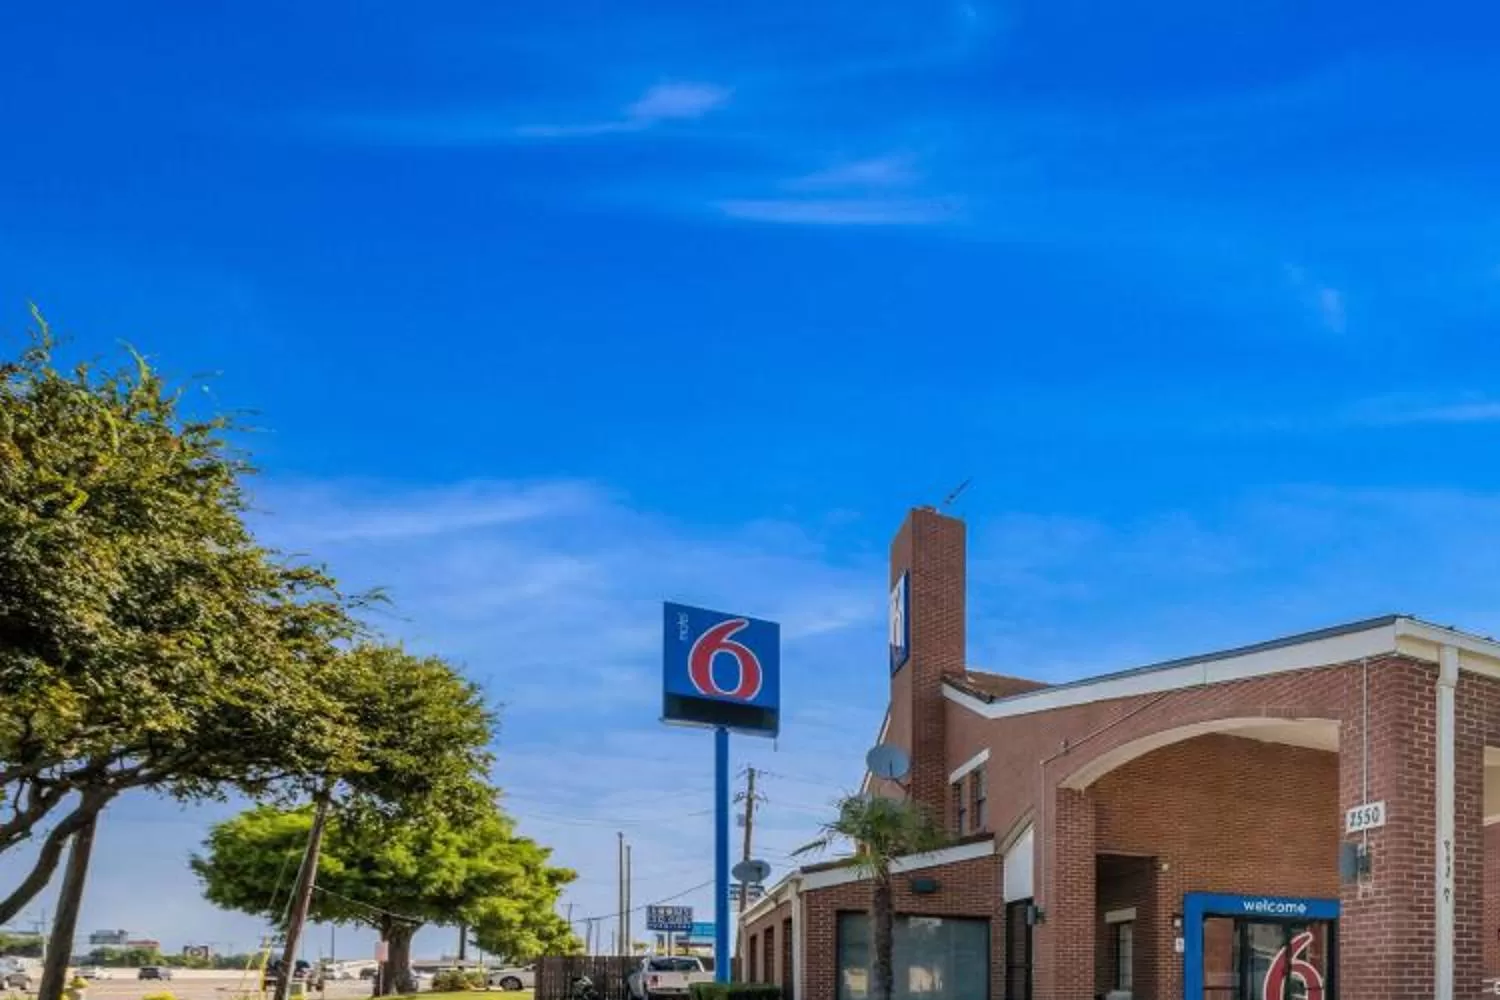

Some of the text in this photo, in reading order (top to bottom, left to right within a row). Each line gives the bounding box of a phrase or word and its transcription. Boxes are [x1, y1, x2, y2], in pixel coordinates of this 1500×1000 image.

[688, 618, 762, 702] 6
[1350, 806, 1381, 829] 2550
[1243, 898, 1307, 913] welcome
